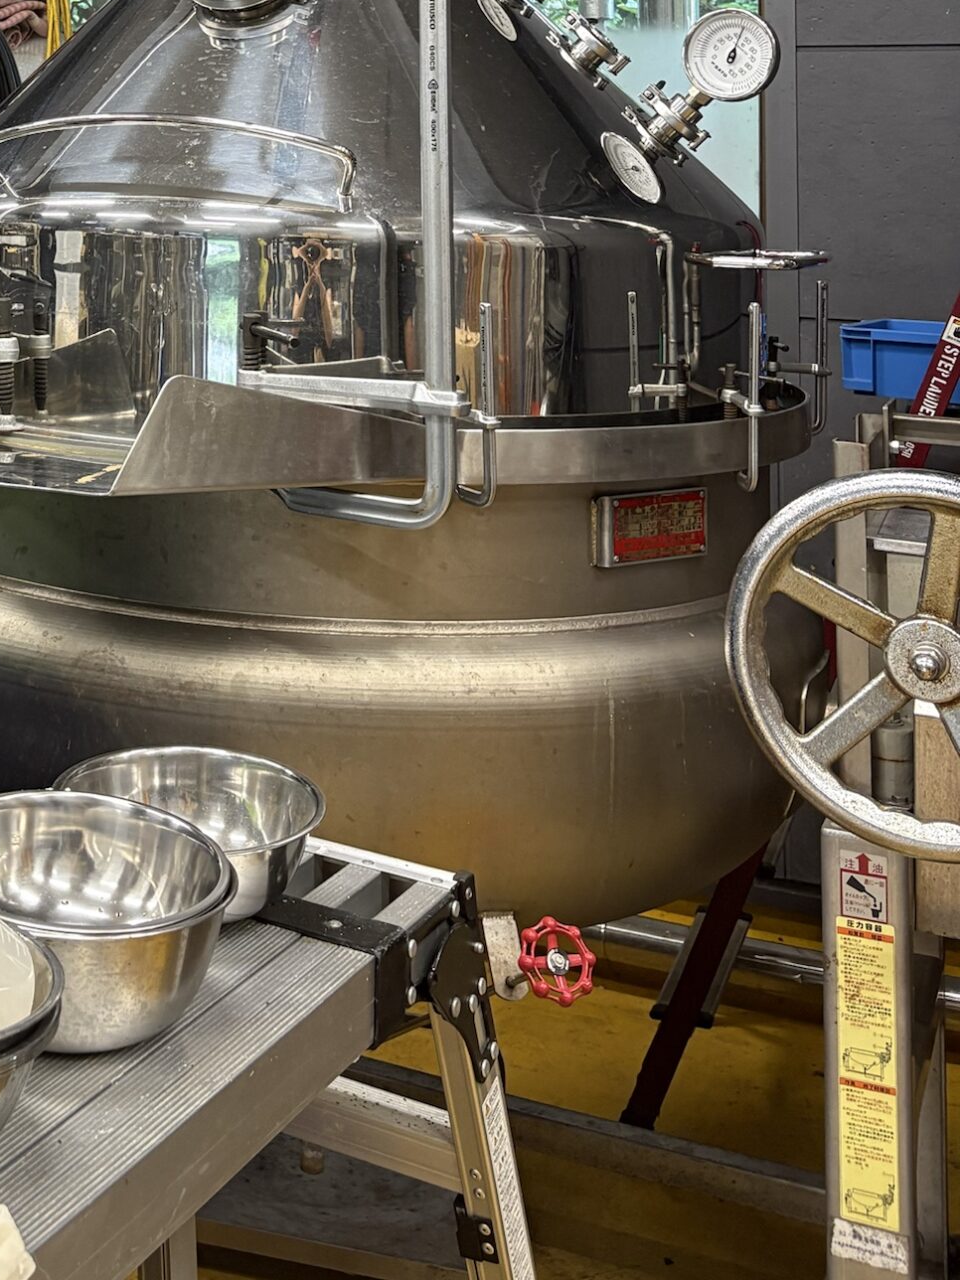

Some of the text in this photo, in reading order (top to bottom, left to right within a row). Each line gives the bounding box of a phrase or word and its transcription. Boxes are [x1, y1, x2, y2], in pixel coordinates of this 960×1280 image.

[936, 344, 960, 379] STEP
[917, 376, 948, 417] LADDE
[872, 863, 884, 874] 油
